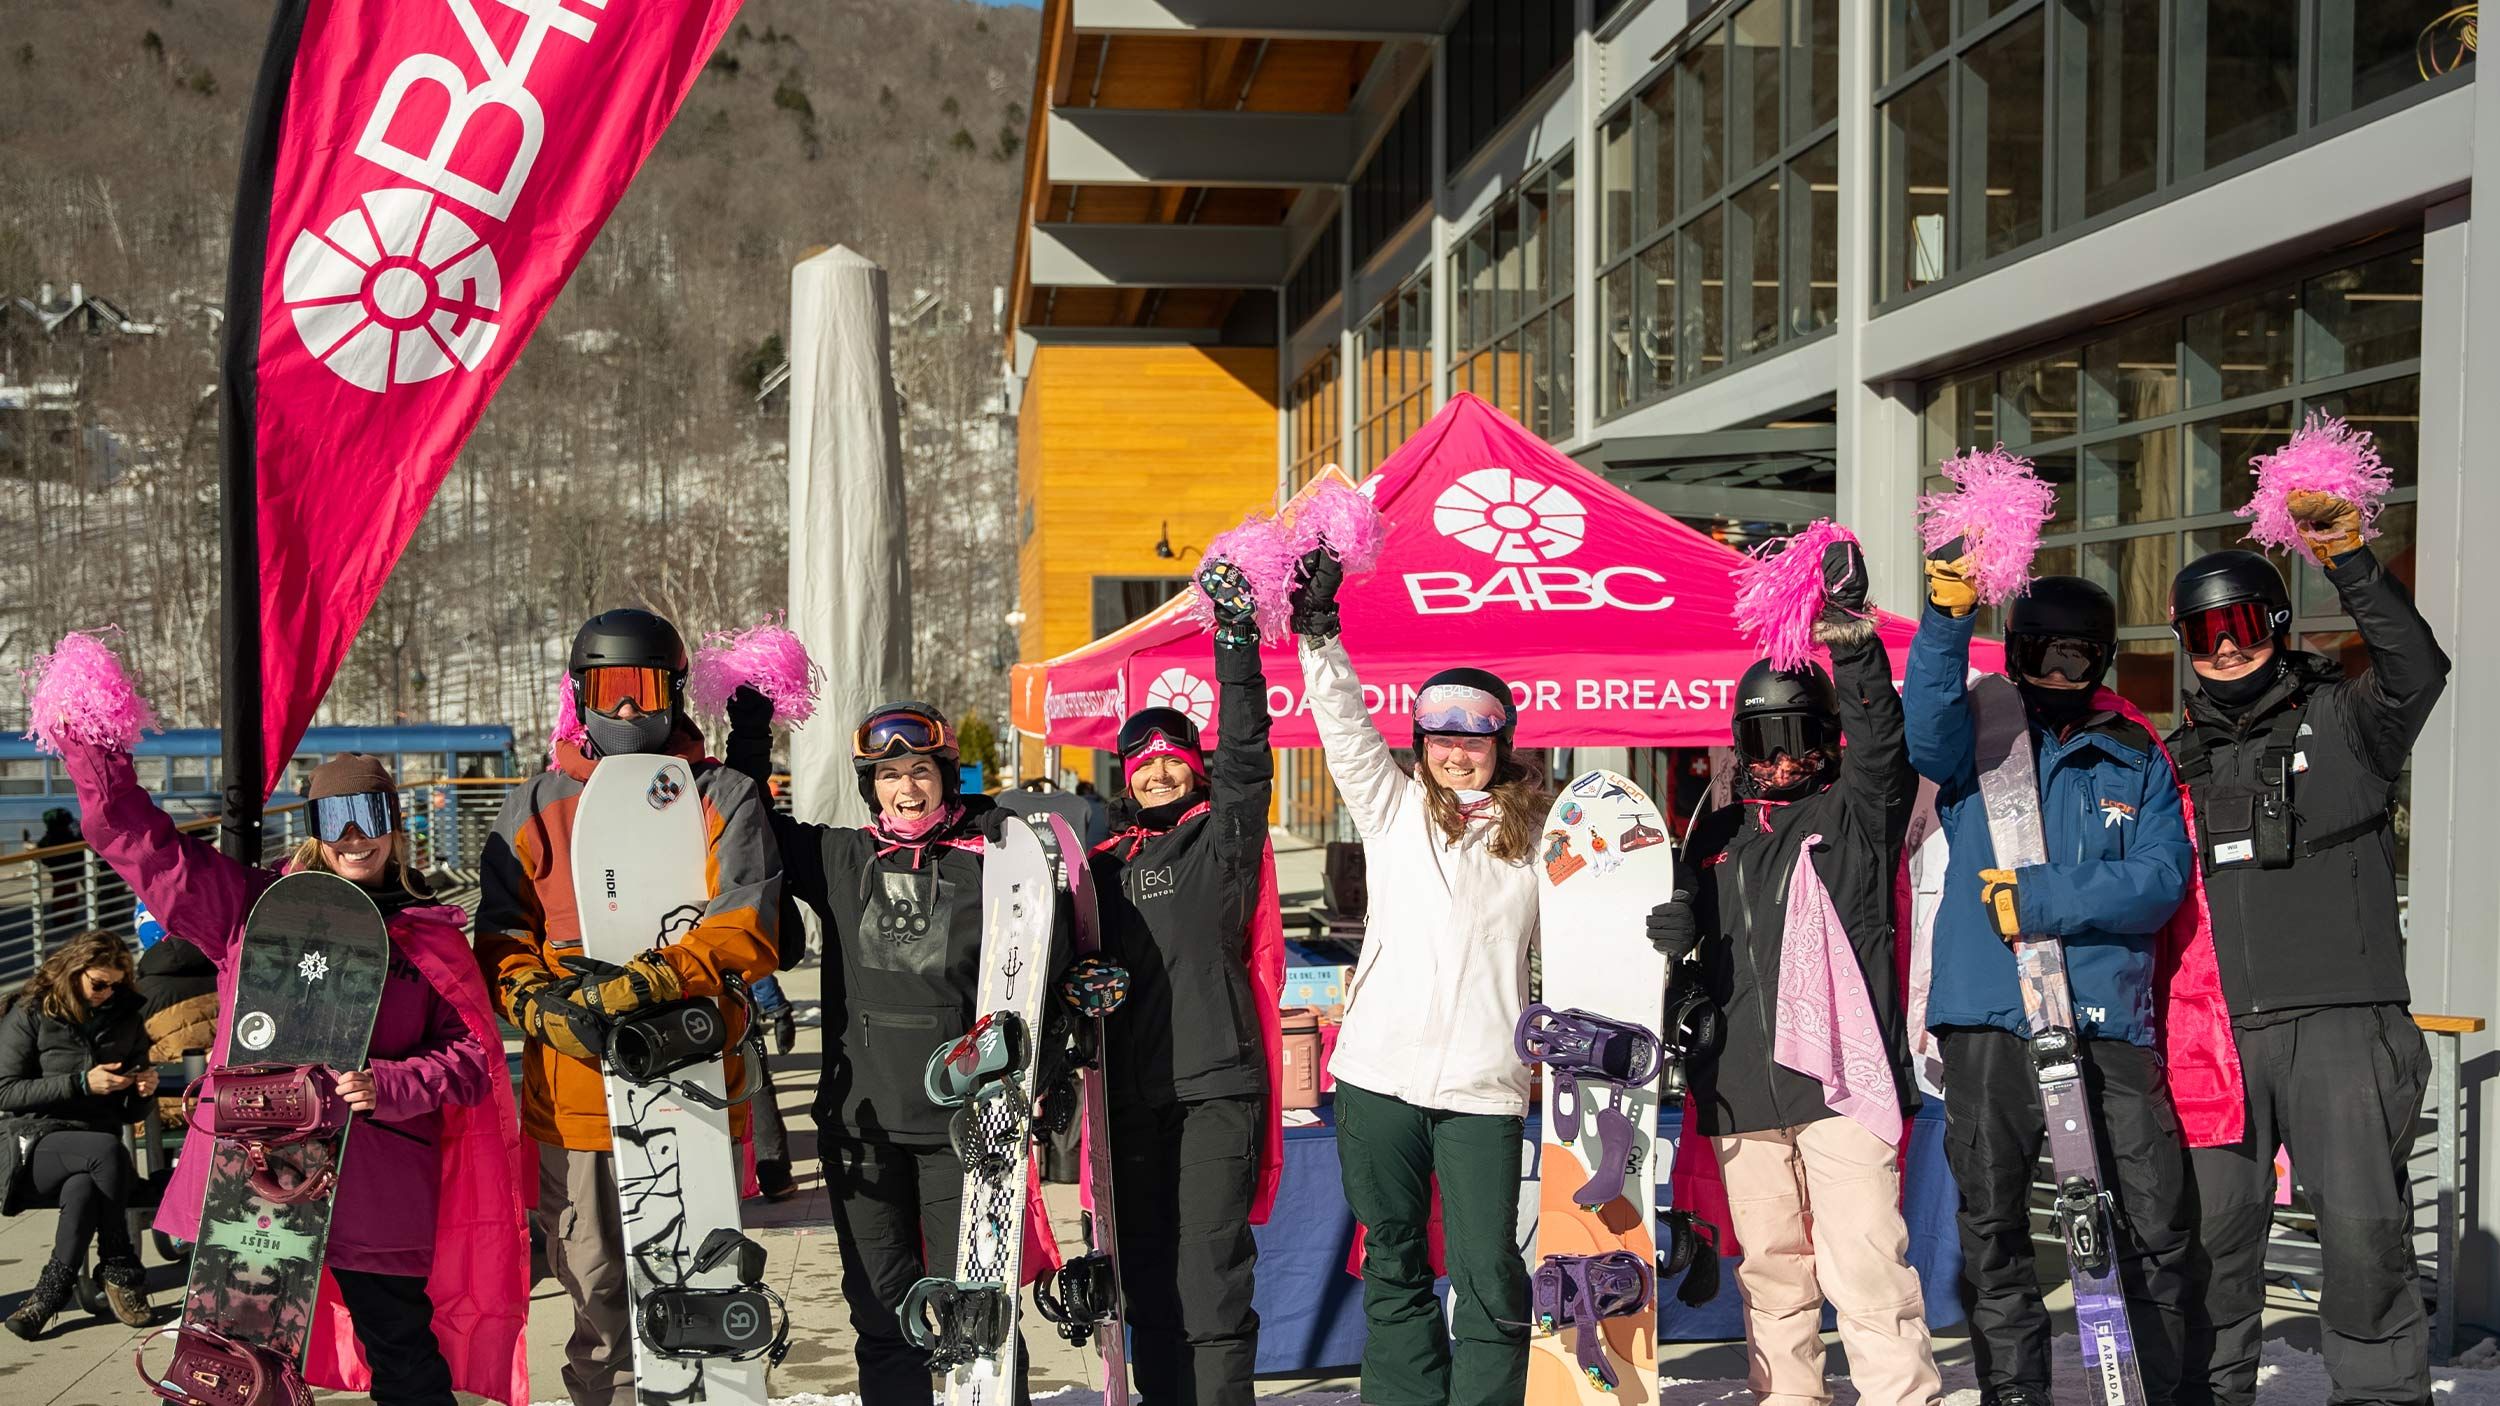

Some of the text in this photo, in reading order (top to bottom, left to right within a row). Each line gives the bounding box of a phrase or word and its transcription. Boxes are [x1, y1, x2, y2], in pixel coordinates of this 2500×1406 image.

[354, 0, 608, 222] B4
[1402, 566, 1676, 614] B4BC
[1507, 680, 1561, 711] OR
[1576, 679, 1735, 710] BREAST
[1745, 697, 1765, 706] SMITH
[1027, 812, 1050, 824] GET
[605, 869, 617, 898] RIDE
[1142, 889, 1174, 900] BURTON
[607, 1049, 618, 1070] RIDE
[240, 1235, 281, 1250] HEIST
[2103, 1344, 2119, 1400] ARMADA
